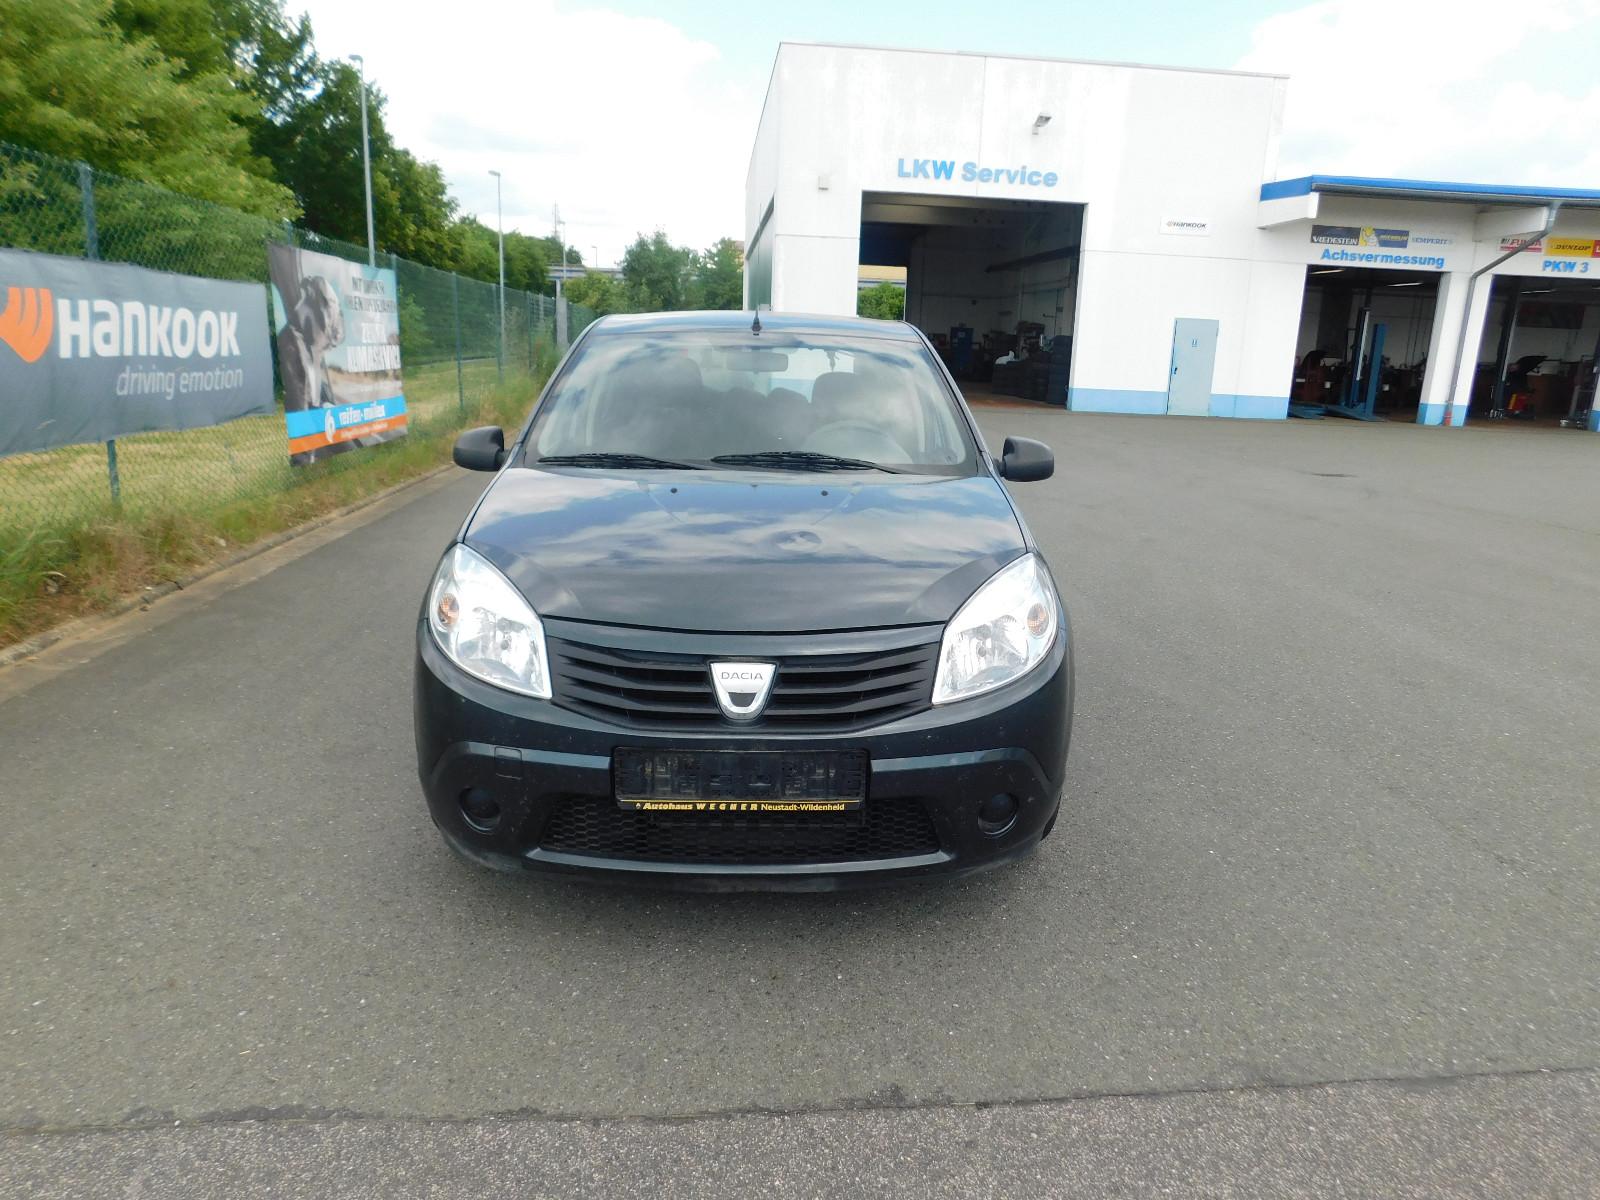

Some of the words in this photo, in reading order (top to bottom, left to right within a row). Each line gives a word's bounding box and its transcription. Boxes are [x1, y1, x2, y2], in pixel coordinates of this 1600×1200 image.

[898, 158, 955, 180] LKW
[961, 162, 1059, 187] Service
[1555, 243, 1591, 251] DUNLOP
[1321, 248, 1445, 269] Achsvermessung
[1542, 260, 1577, 273] PKW
[1580, 261, 1589, 273] 3
[116, 364, 176, 401] driving
[178, 363, 244, 394] emotion
[720, 671, 764, 681] DACIA
[642, 802, 693, 811] Autohaus
